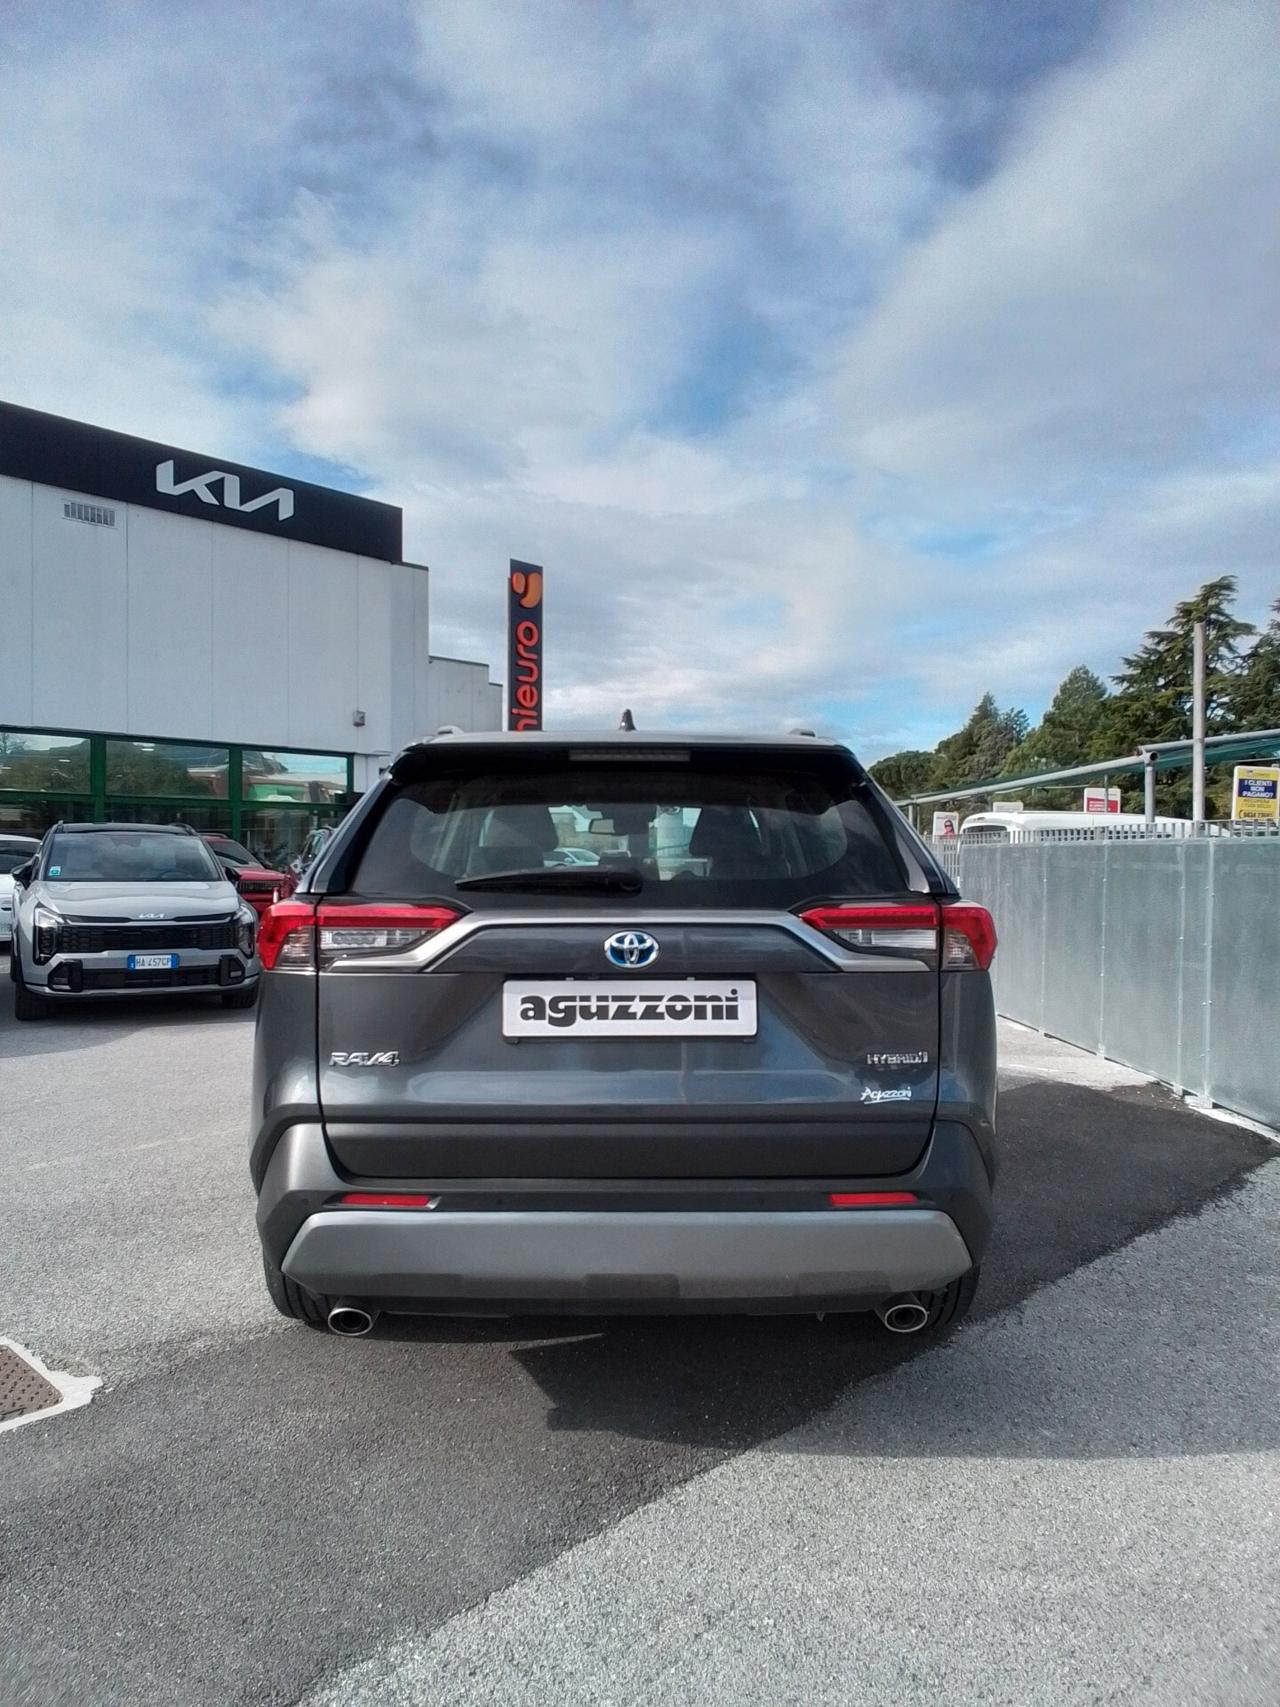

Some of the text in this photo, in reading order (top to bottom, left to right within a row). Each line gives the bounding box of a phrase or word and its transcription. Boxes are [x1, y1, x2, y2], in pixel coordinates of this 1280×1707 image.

[156, 459, 295, 521] KIA
[519, 988, 740, 1028] aguzzoni
[329, 1050, 400, 1067] RAV4
